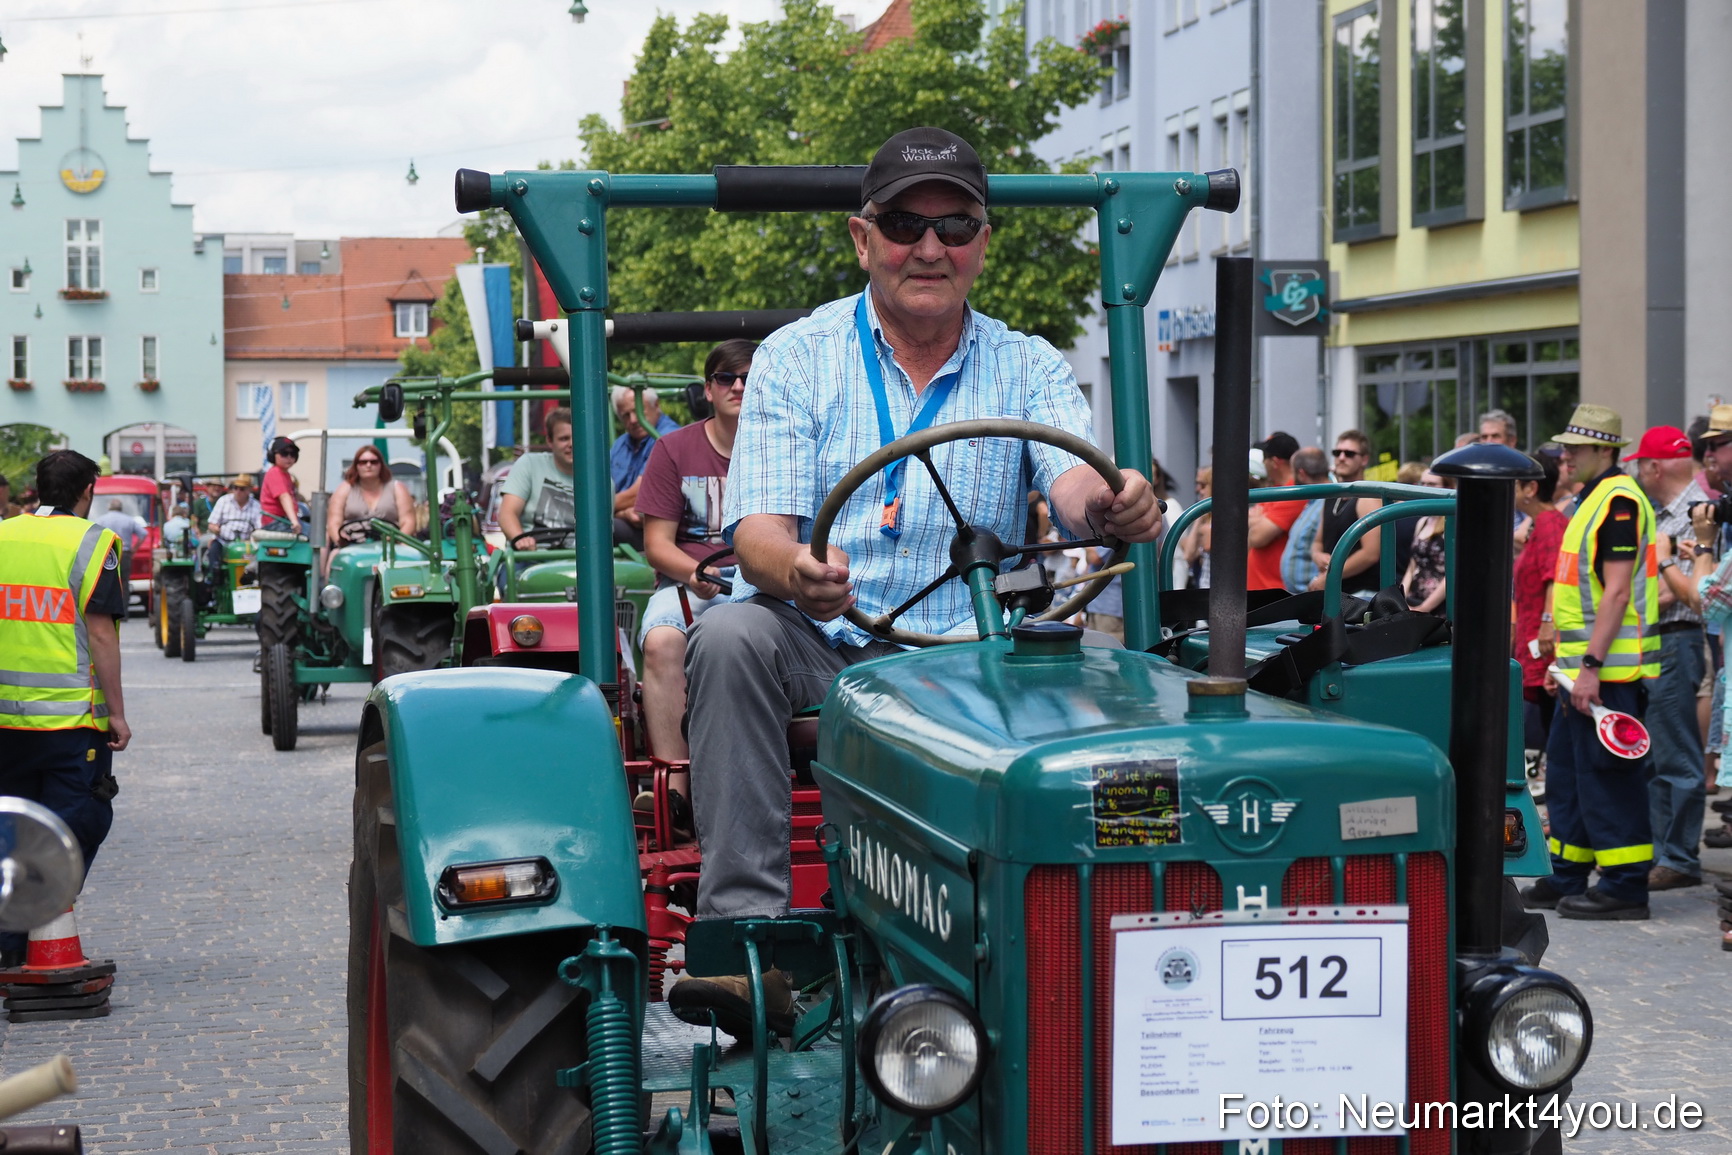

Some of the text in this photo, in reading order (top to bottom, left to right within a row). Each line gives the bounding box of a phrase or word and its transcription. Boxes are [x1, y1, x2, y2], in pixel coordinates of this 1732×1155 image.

[902, 145, 933, 154] Jack
[902, 152, 957, 162] Wolfskin
[0, 585, 68, 621] HW
[1097, 768, 1119, 781] Das
[850, 824, 951, 942] HANOMAG
[1254, 955, 1348, 1001] 512
